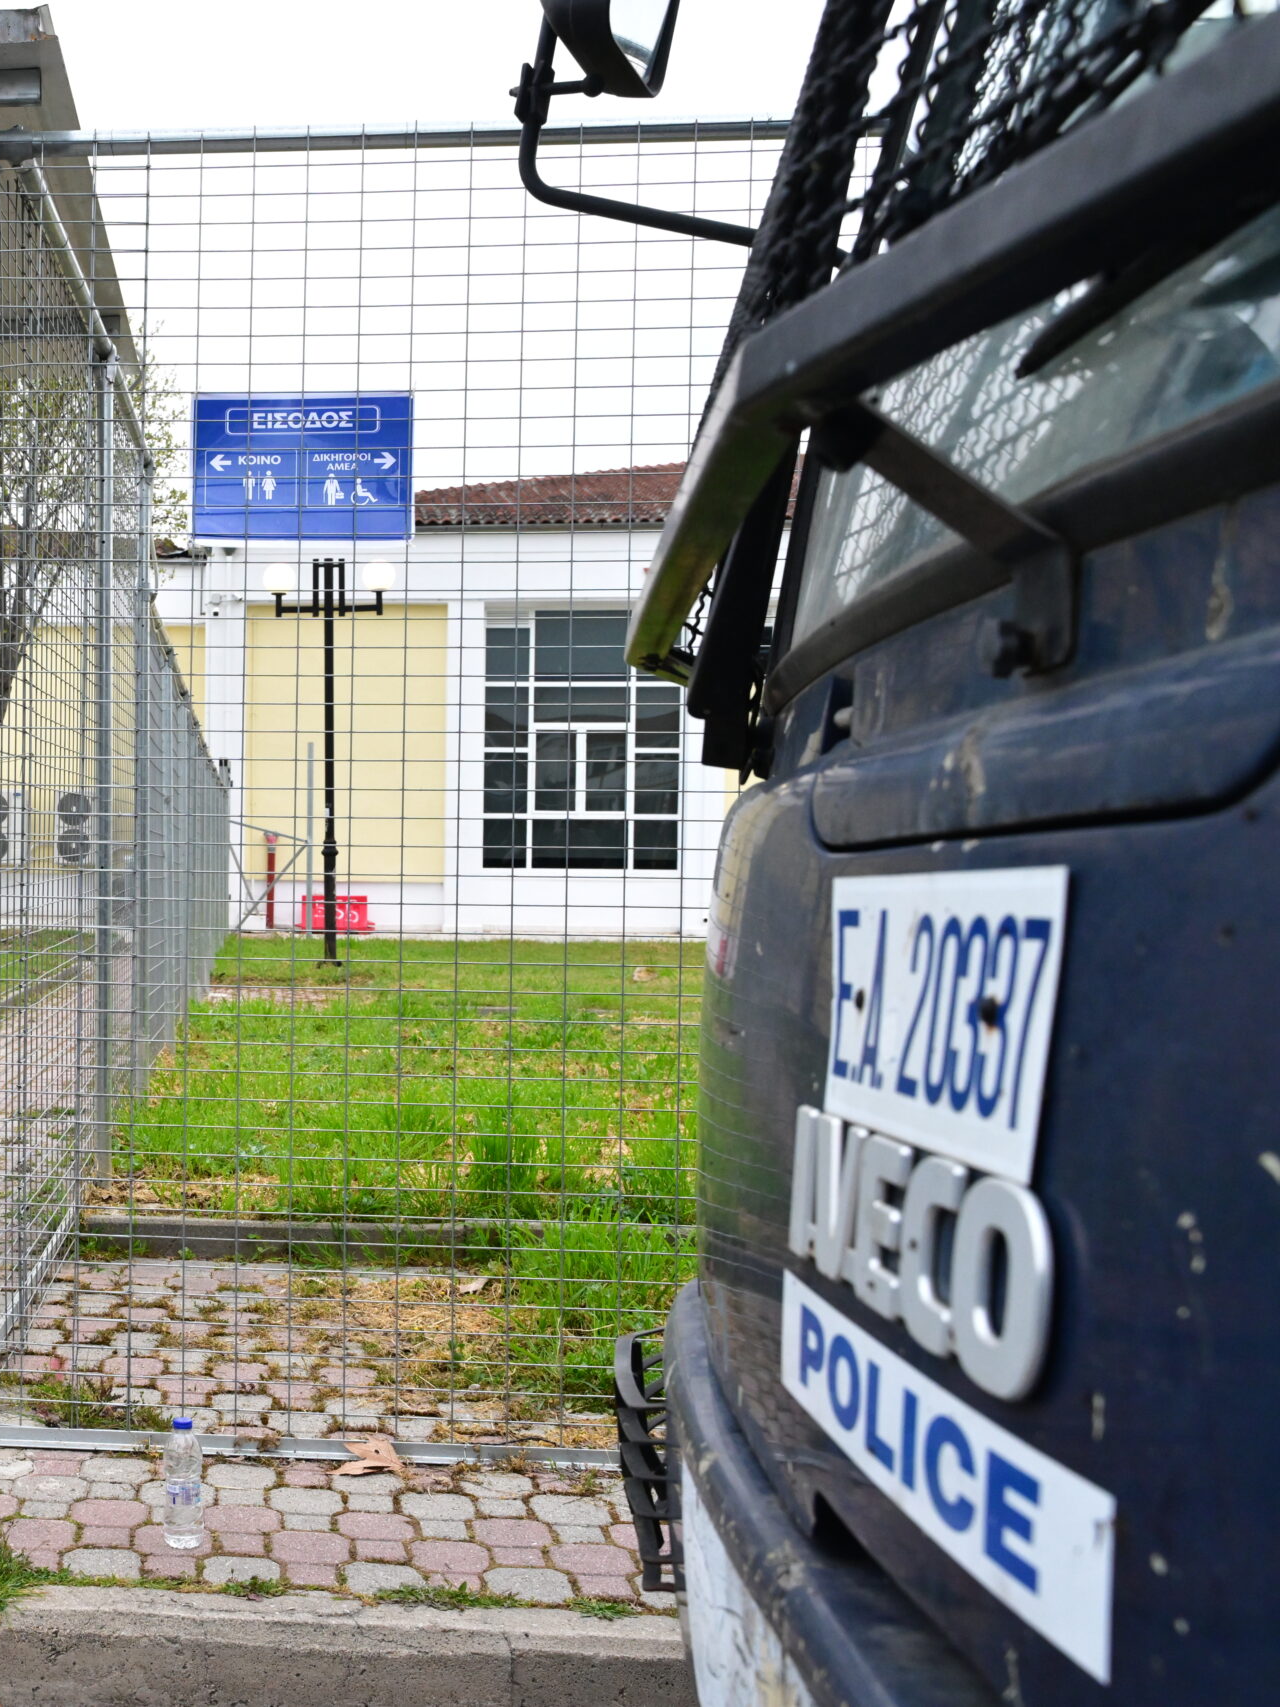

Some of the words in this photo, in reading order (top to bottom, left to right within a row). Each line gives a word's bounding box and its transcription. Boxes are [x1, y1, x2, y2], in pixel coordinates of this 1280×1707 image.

[252, 411, 354, 430] ΕΙΣΟΔΟΣ
[238, 455, 282, 466] ΚΟΙΝΟ
[312, 453, 371, 463] ΔΙΚΗΓΟΡΟΙ
[326, 462, 359, 471] ΑΜΕΑ
[895, 914, 1053, 1131] 20337
[788, 1104, 1055, 1401] IVECO
[799, 1301, 1042, 1595] POLICE
